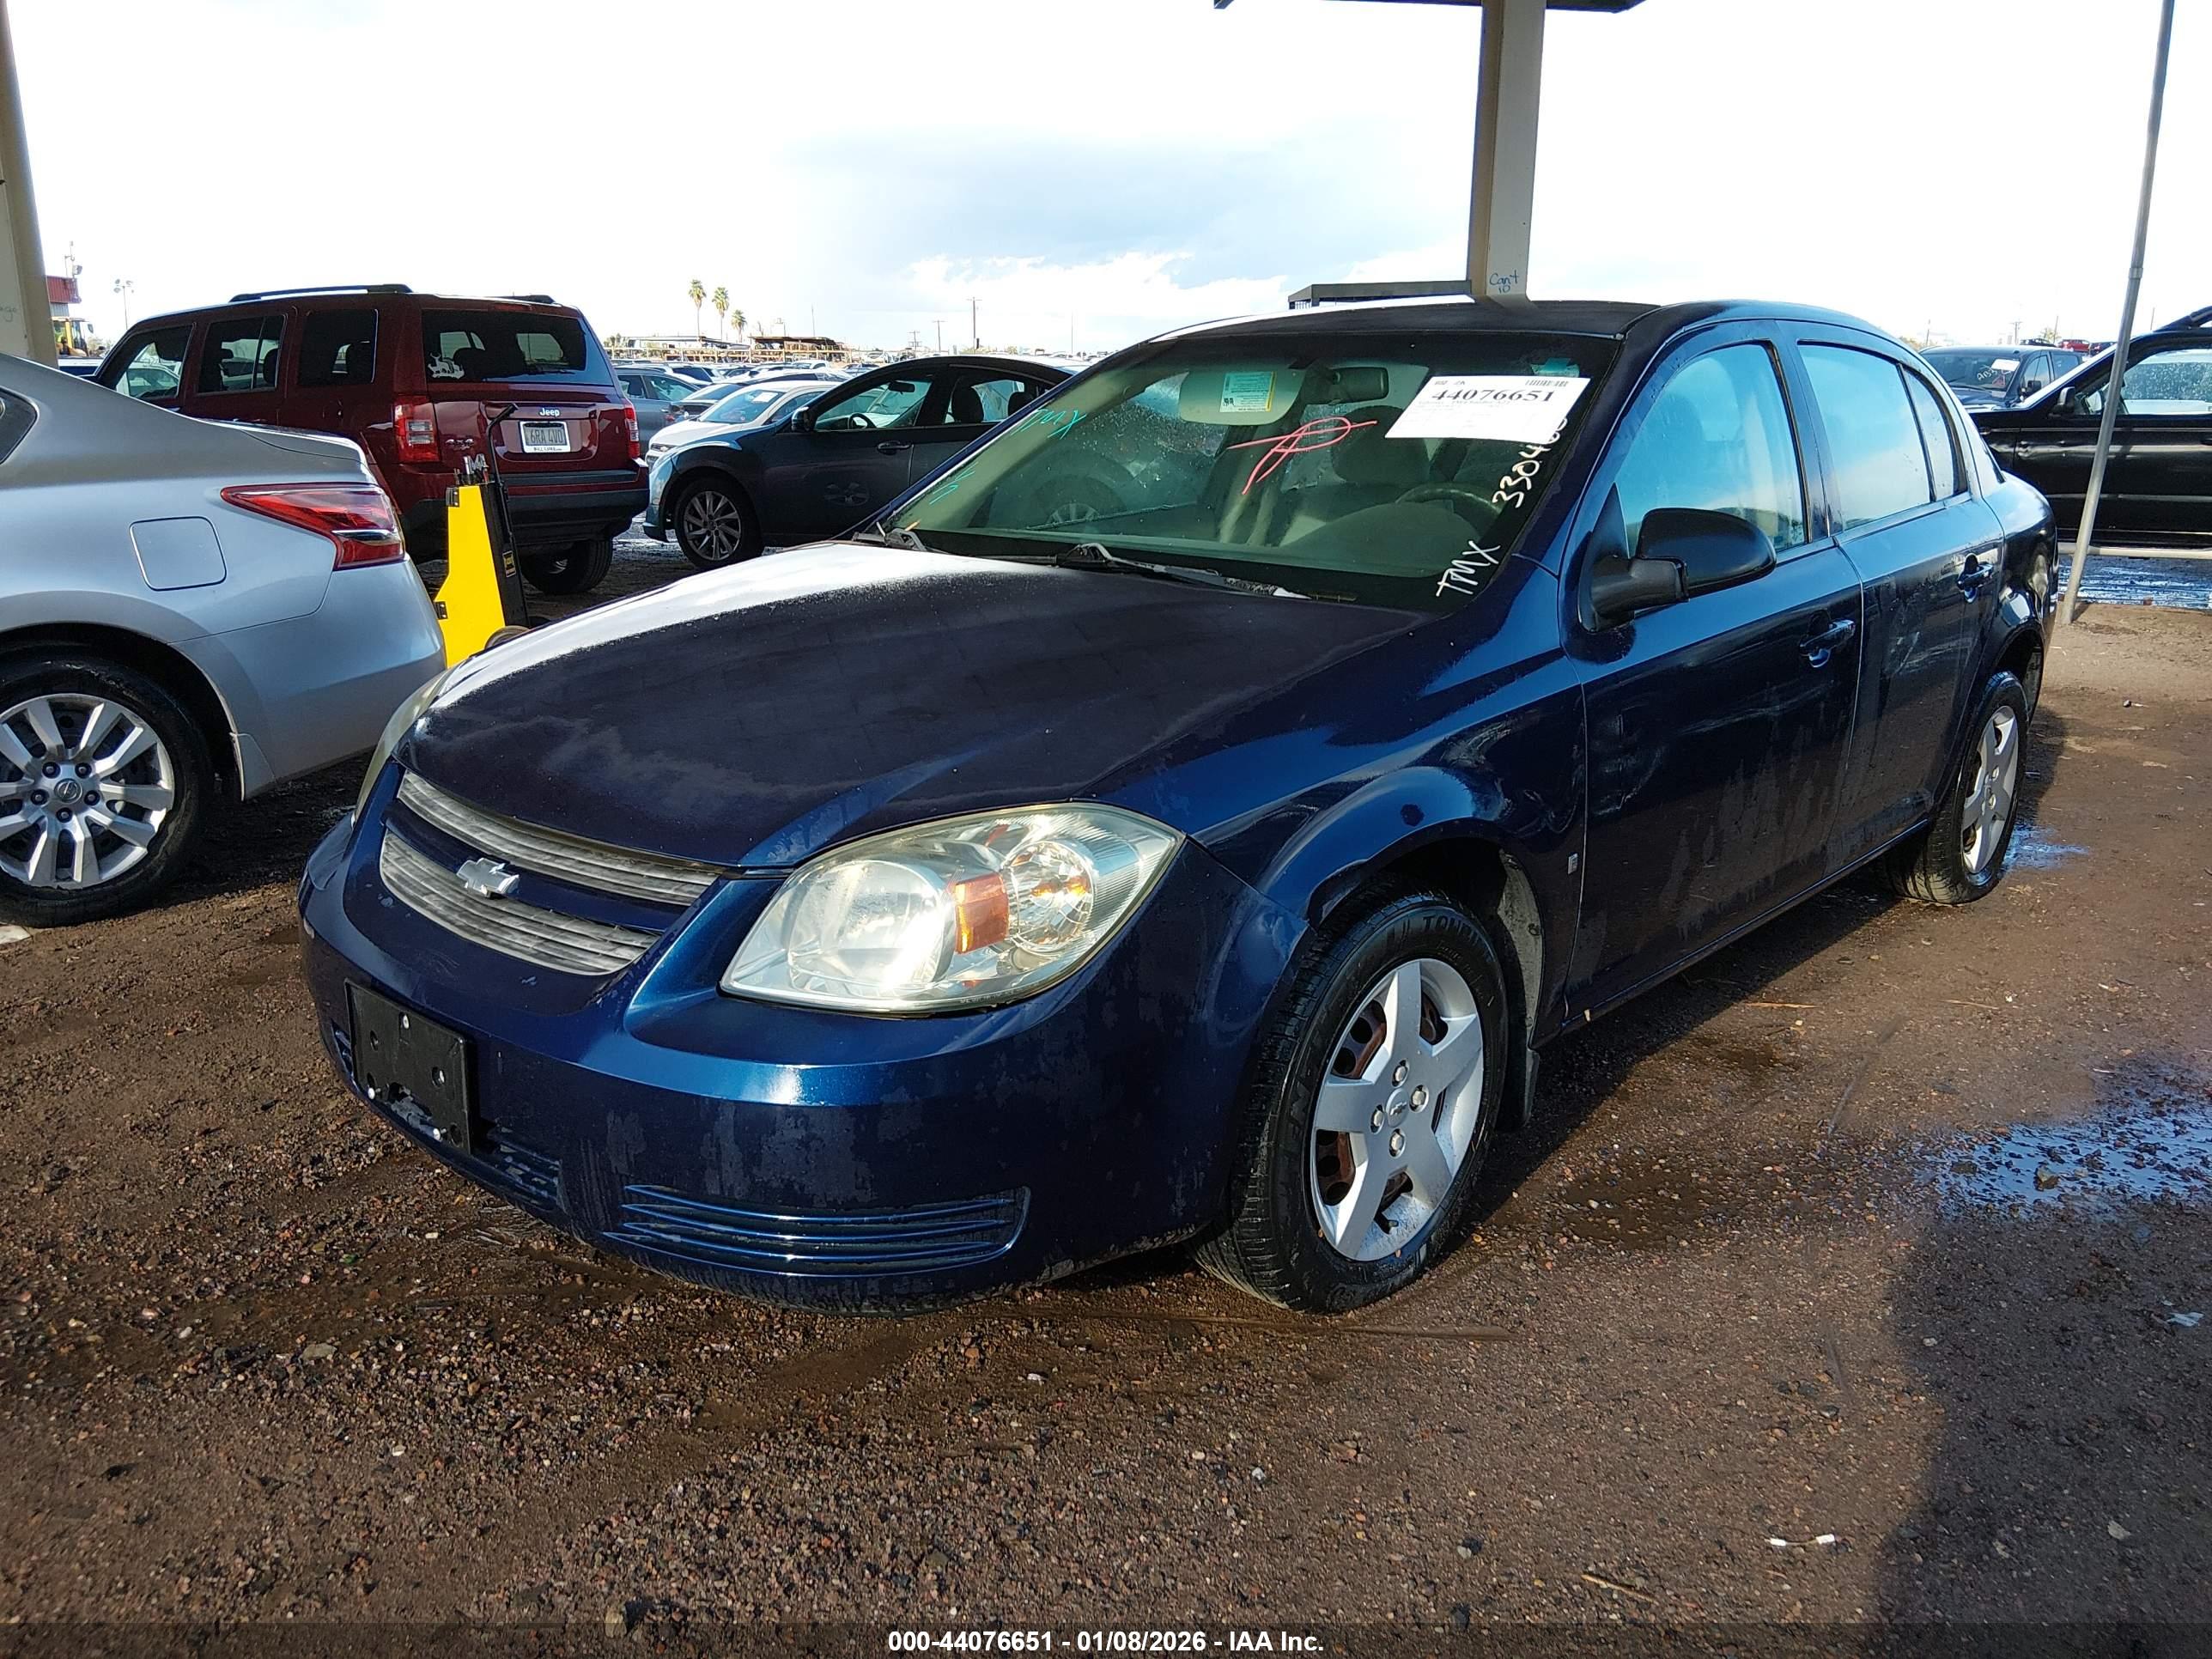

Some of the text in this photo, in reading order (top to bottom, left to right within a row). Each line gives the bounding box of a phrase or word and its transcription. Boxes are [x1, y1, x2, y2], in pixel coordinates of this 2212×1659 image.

[1431, 388, 1556, 403] 44076651
[539, 407, 560, 418] Jeep
[1435, 540, 1501, 598] TMX
